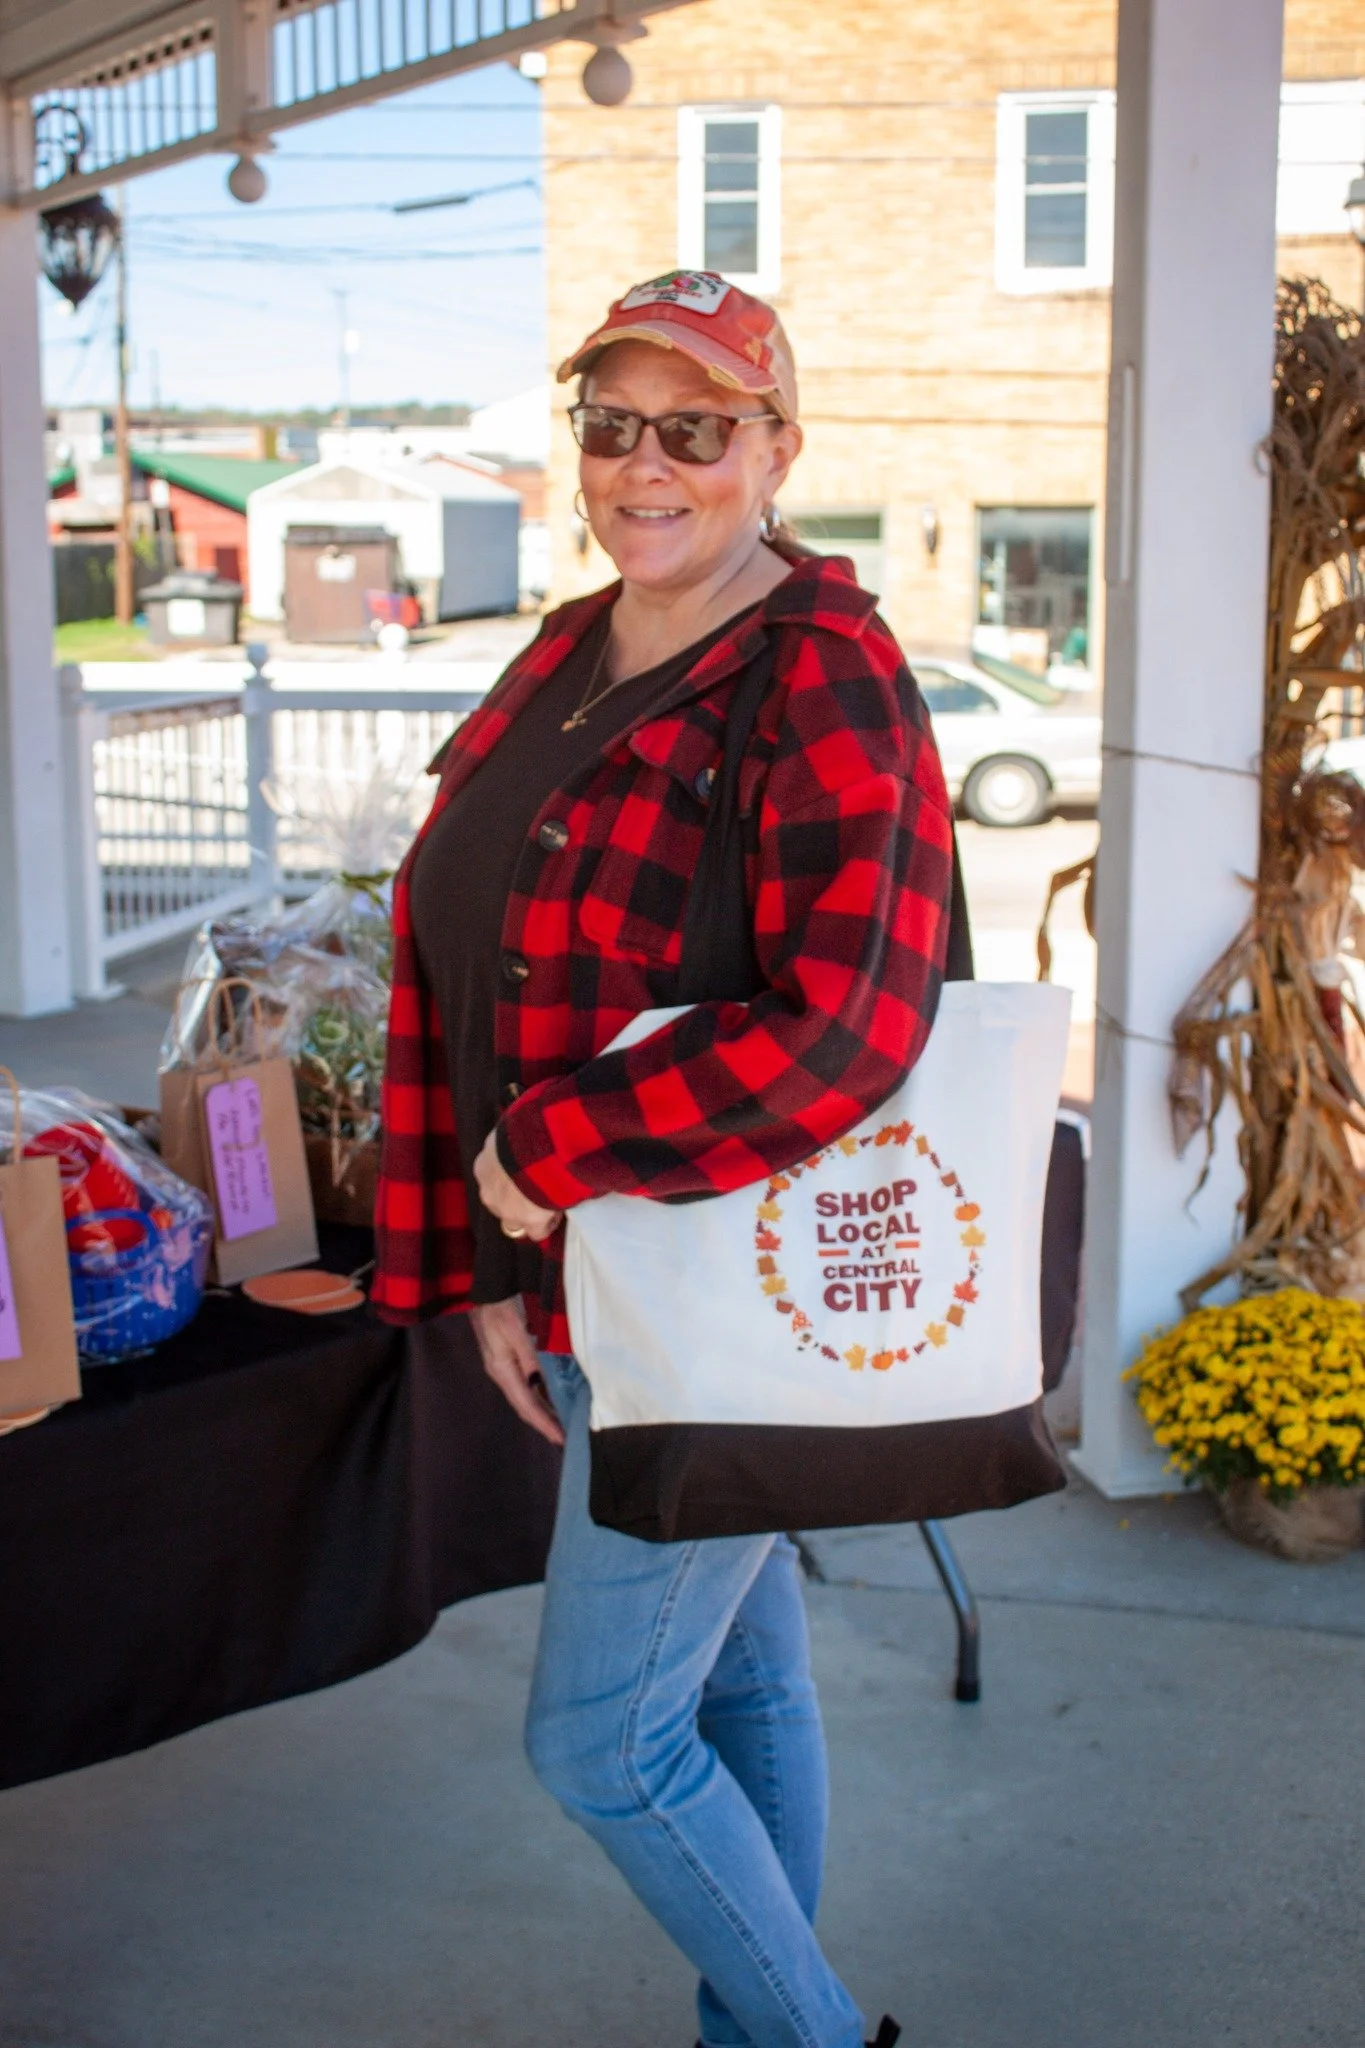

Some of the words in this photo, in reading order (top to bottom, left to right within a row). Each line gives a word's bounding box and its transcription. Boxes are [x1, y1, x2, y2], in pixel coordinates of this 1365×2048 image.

[815, 1179, 918, 1217] SHOP
[816, 1211, 921, 1243] LOCAL
[861, 1244, 887, 1259] AT
[822, 1259, 921, 1280] CENTRAL
[823, 1278, 922, 1312] CITY
